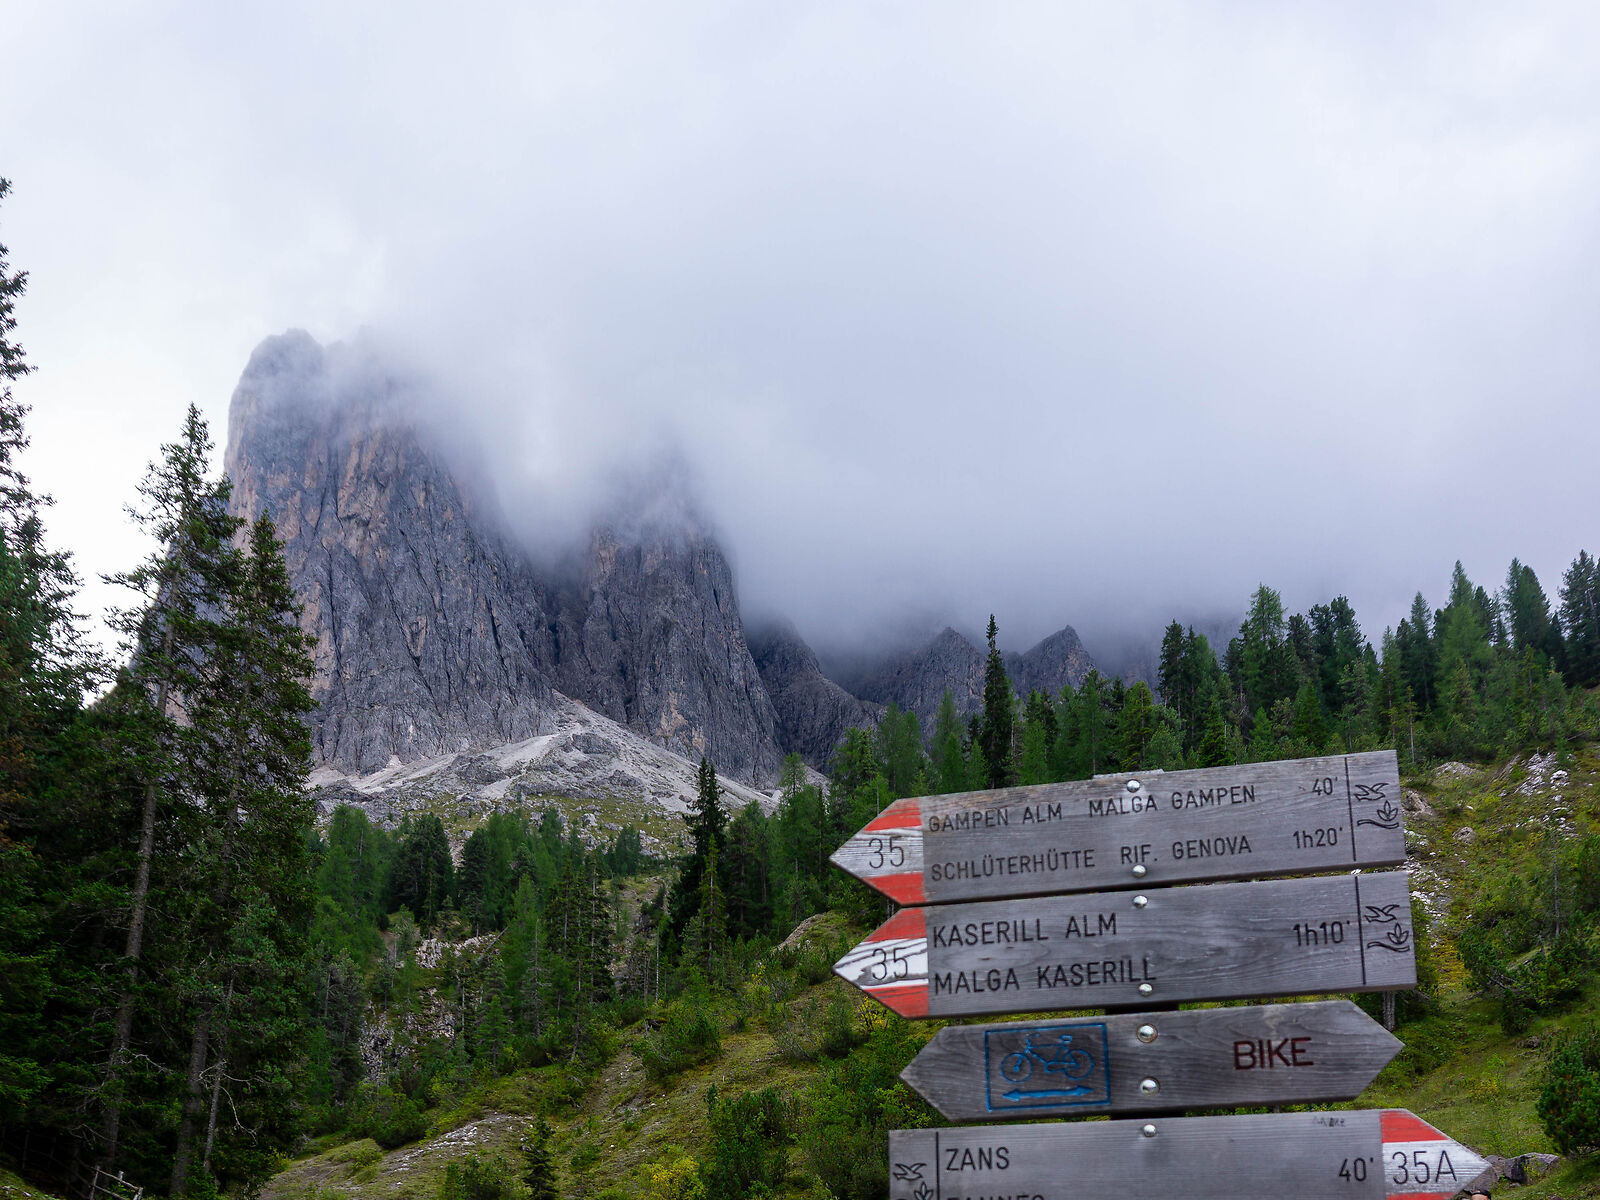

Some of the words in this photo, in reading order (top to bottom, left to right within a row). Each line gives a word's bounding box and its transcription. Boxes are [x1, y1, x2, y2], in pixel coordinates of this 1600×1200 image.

[928, 808, 1009, 833] GAMPEN
[1022, 802, 1063, 825] ALM
[1089, 794, 1158, 818] MALGA
[1172, 784, 1256, 810] GAMPEN
[1312, 776, 1339, 797] 40'
[868, 836, 905, 869] 35
[931, 848, 1096, 882] SCHLÜTERHÜTTE
[1121, 844, 1158, 865] RIF.
[1172, 835, 1252, 860] GENOVA
[933, 918, 1049, 949] KASERILL
[1065, 912, 1118, 939] ALM
[871, 947, 908, 980] 35
[934, 968, 1020, 996] MALGA
[1037, 957, 1157, 989] KASERILL
[1233, 1036, 1315, 1070] BIKE
[946, 1146, 1010, 1171] ZANS
[1339, 1156, 1374, 1182] 40'
[1392, 1150, 1457, 1185] 35A
